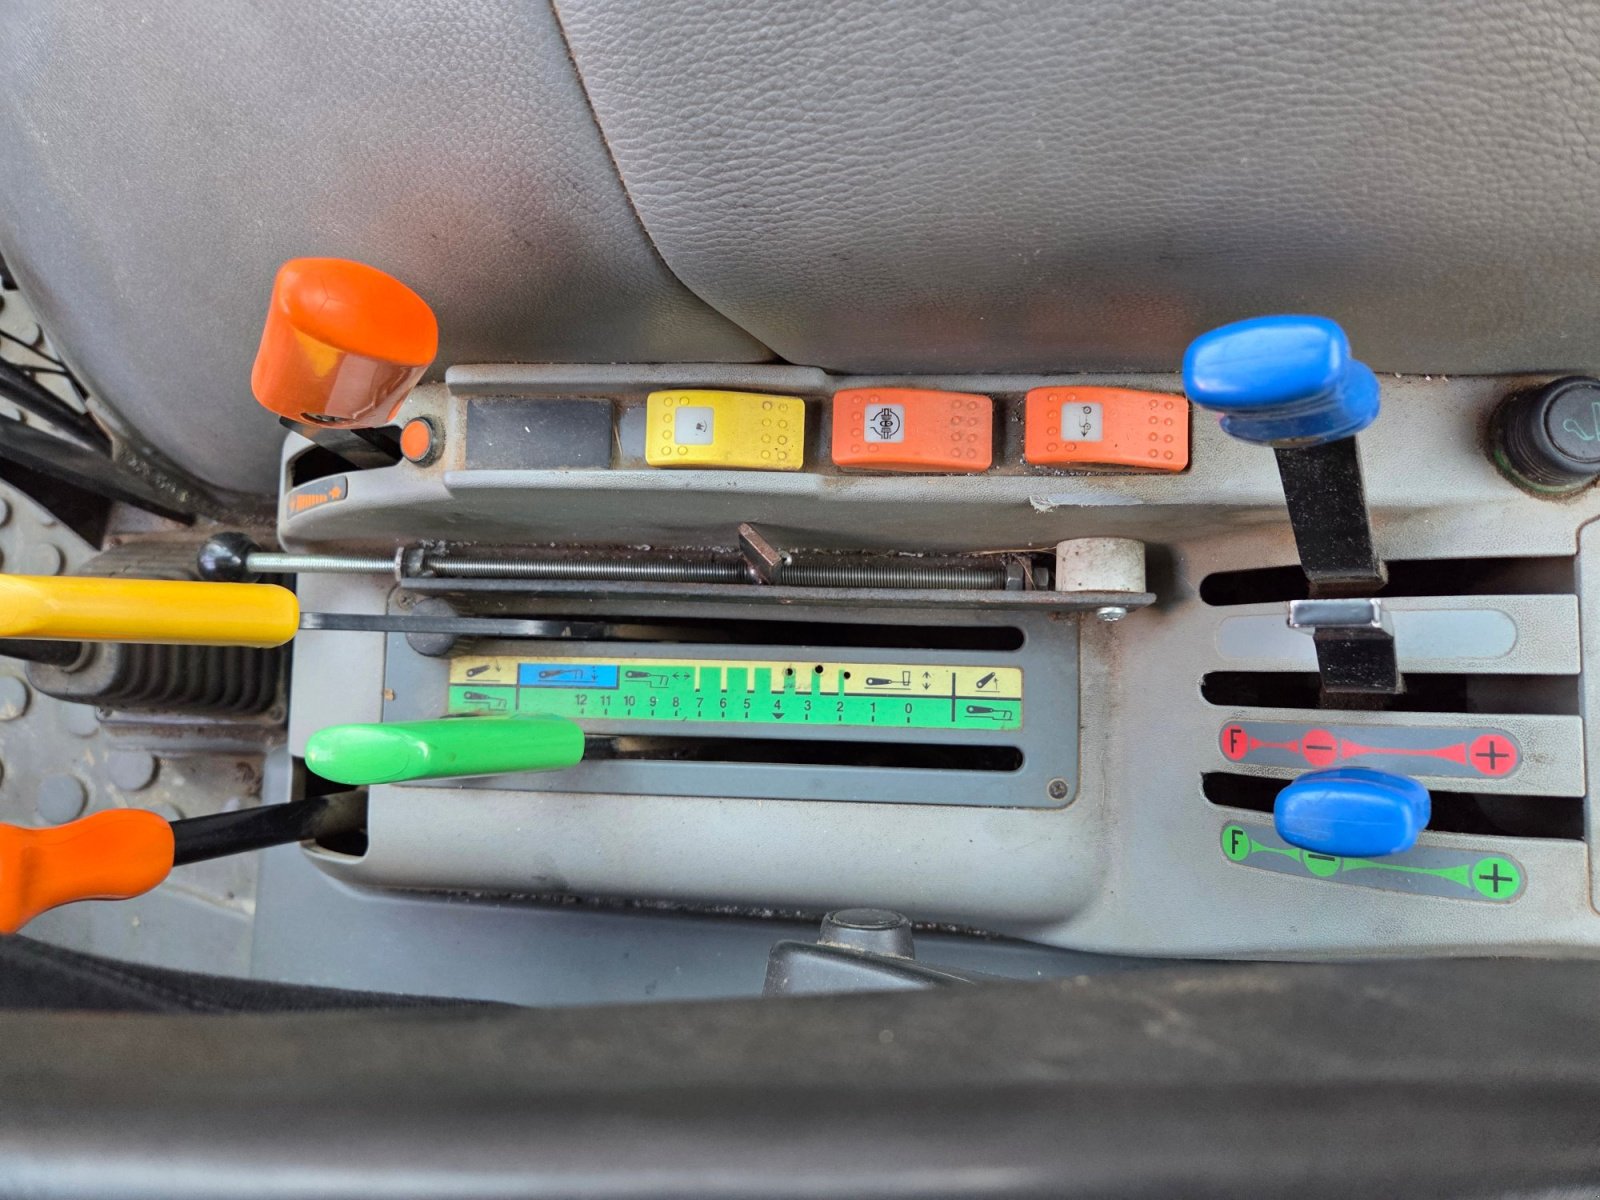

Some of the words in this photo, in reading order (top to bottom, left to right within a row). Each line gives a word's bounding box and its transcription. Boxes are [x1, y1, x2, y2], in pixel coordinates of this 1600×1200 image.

[575, 695, 588, 706] 12
[600, 695, 612, 706] 11
[624, 695, 636, 706] 10
[649, 696, 657, 707] 9
[672, 697, 680, 708] 8
[696, 697, 704, 708] 7
[719, 698, 727, 708] 6
[743, 699, 751, 709] 5
[774, 700, 782, 710] 4
[804, 701, 811, 711] 3
[836, 702, 844, 712] 2
[870, 703, 876, 713] 1
[905, 703, 913, 714] 0
[1230, 729, 1242, 753] F
[1231, 829, 1244, 854] F
